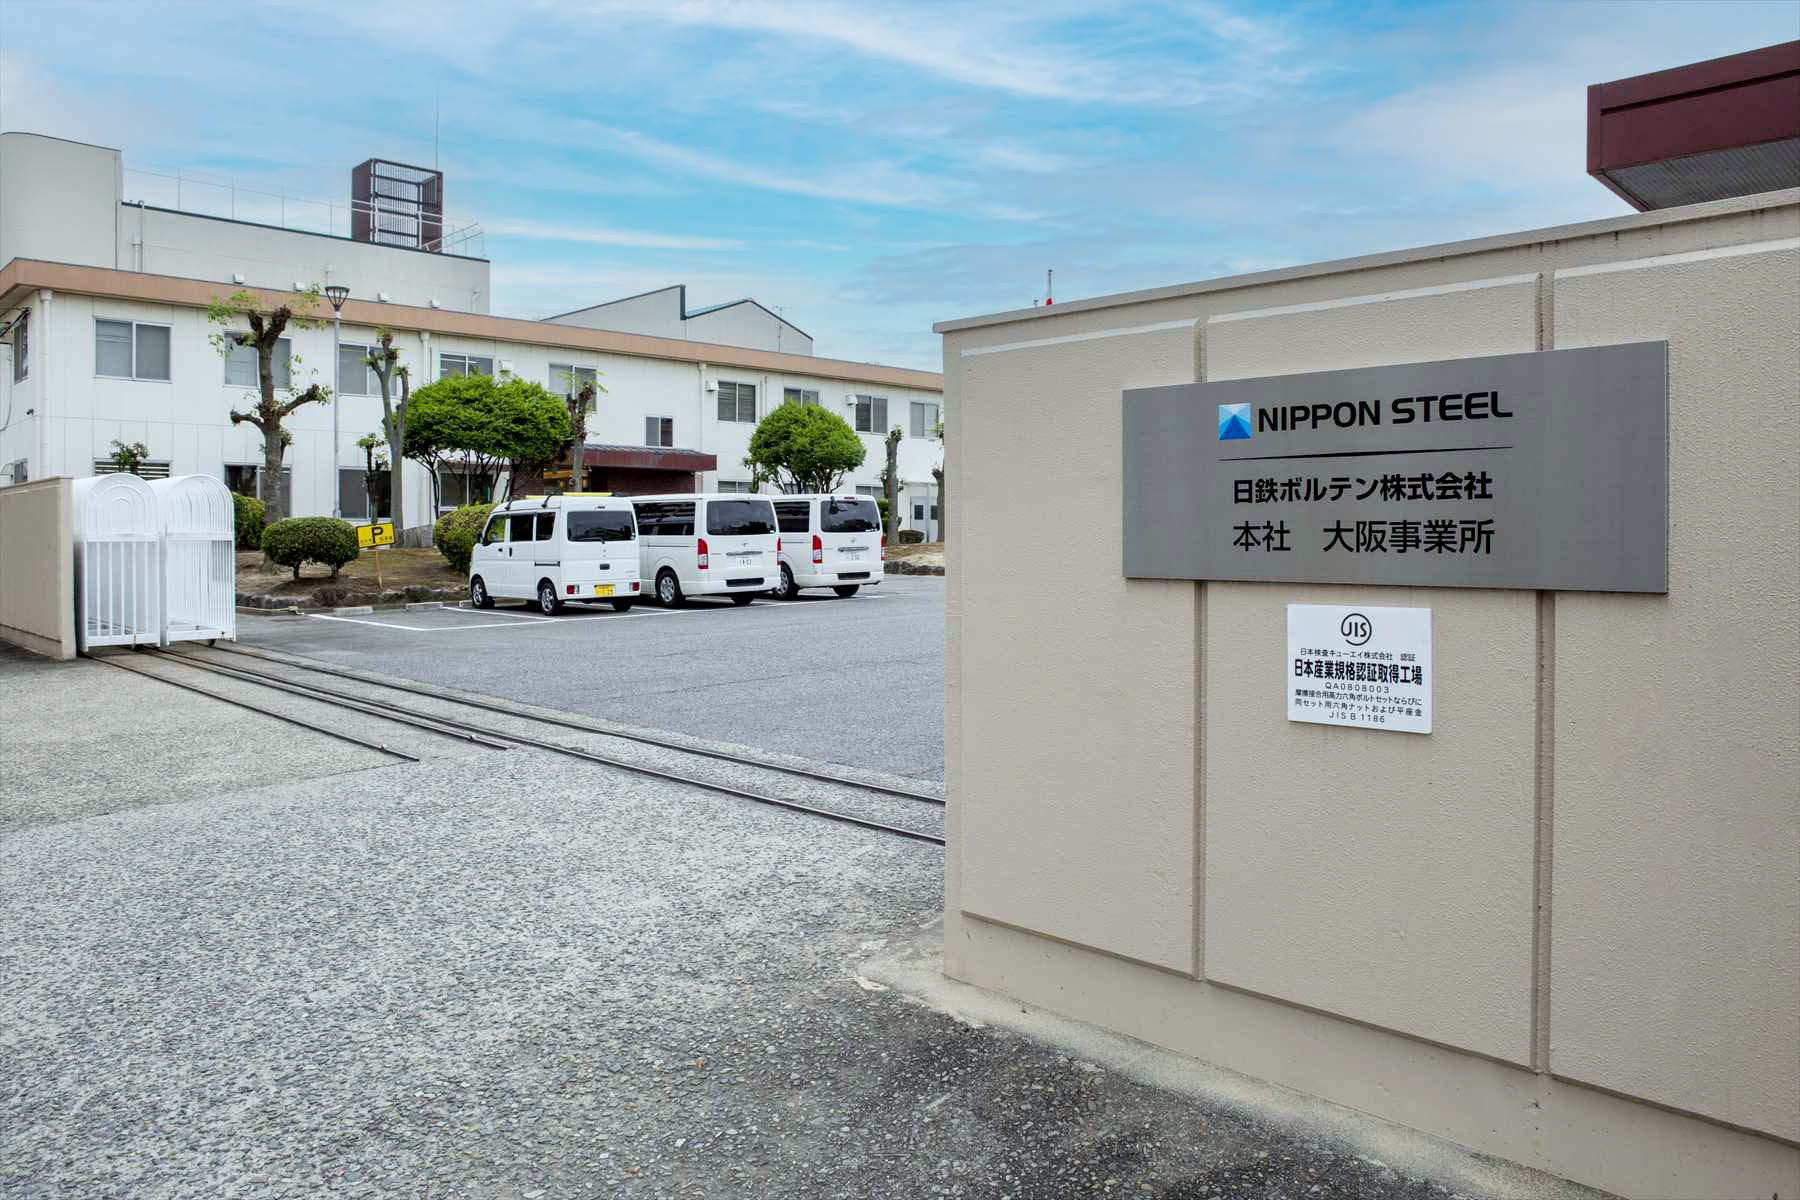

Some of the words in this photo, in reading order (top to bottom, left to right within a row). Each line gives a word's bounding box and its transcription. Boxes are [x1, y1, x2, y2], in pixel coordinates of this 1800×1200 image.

[1258, 400, 1380, 432] NIPPON
[1392, 391, 1513, 424] STEEL
[1233, 471, 1493, 504] 日鉄ボルテン株式会社
[371, 527, 384, 544] P
[1233, 520, 1291, 552] 本社
[1323, 519, 1495, 554] 大阪事業所
[1294, 658, 1423, 685] 日本産業規格認証取得工場
